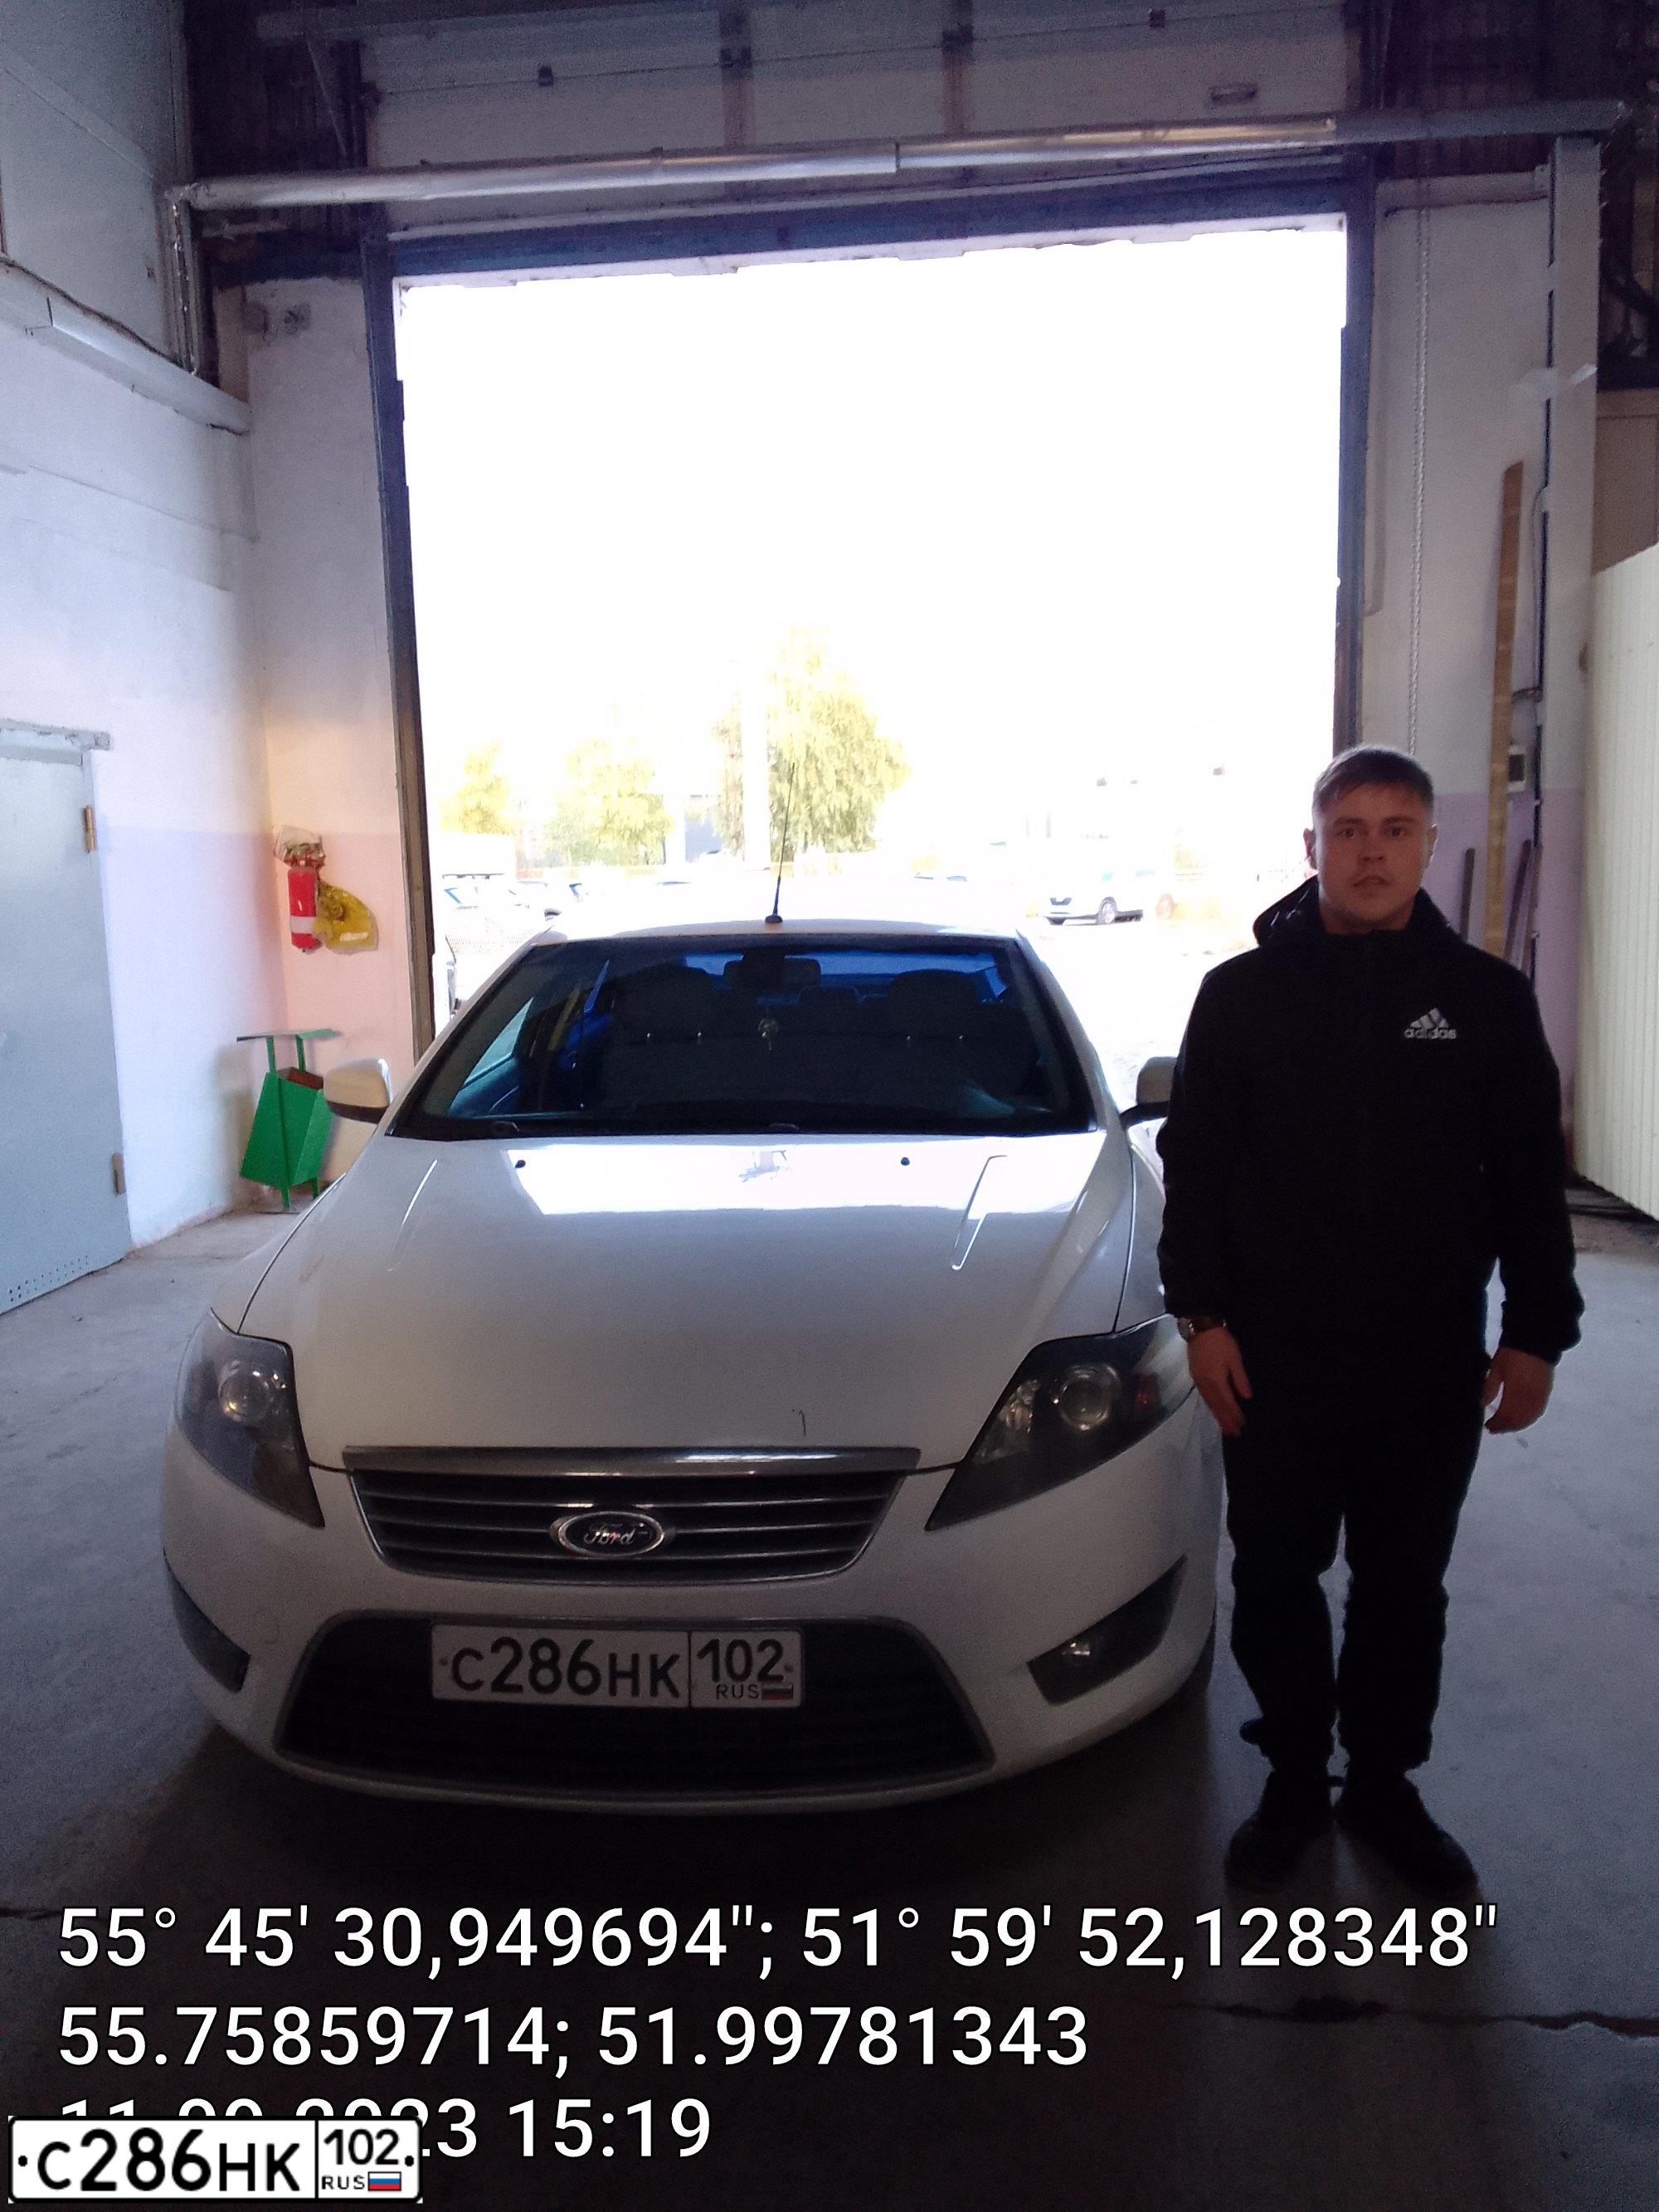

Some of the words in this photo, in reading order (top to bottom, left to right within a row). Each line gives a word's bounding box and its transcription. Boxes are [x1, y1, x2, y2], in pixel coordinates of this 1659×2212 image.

[1404, 1027, 1457, 1040] adidas
[583, 1523, 636, 1545] Ford
[696, 1637, 785, 1684] 102
[716, 1683, 760, 1700] RUS
